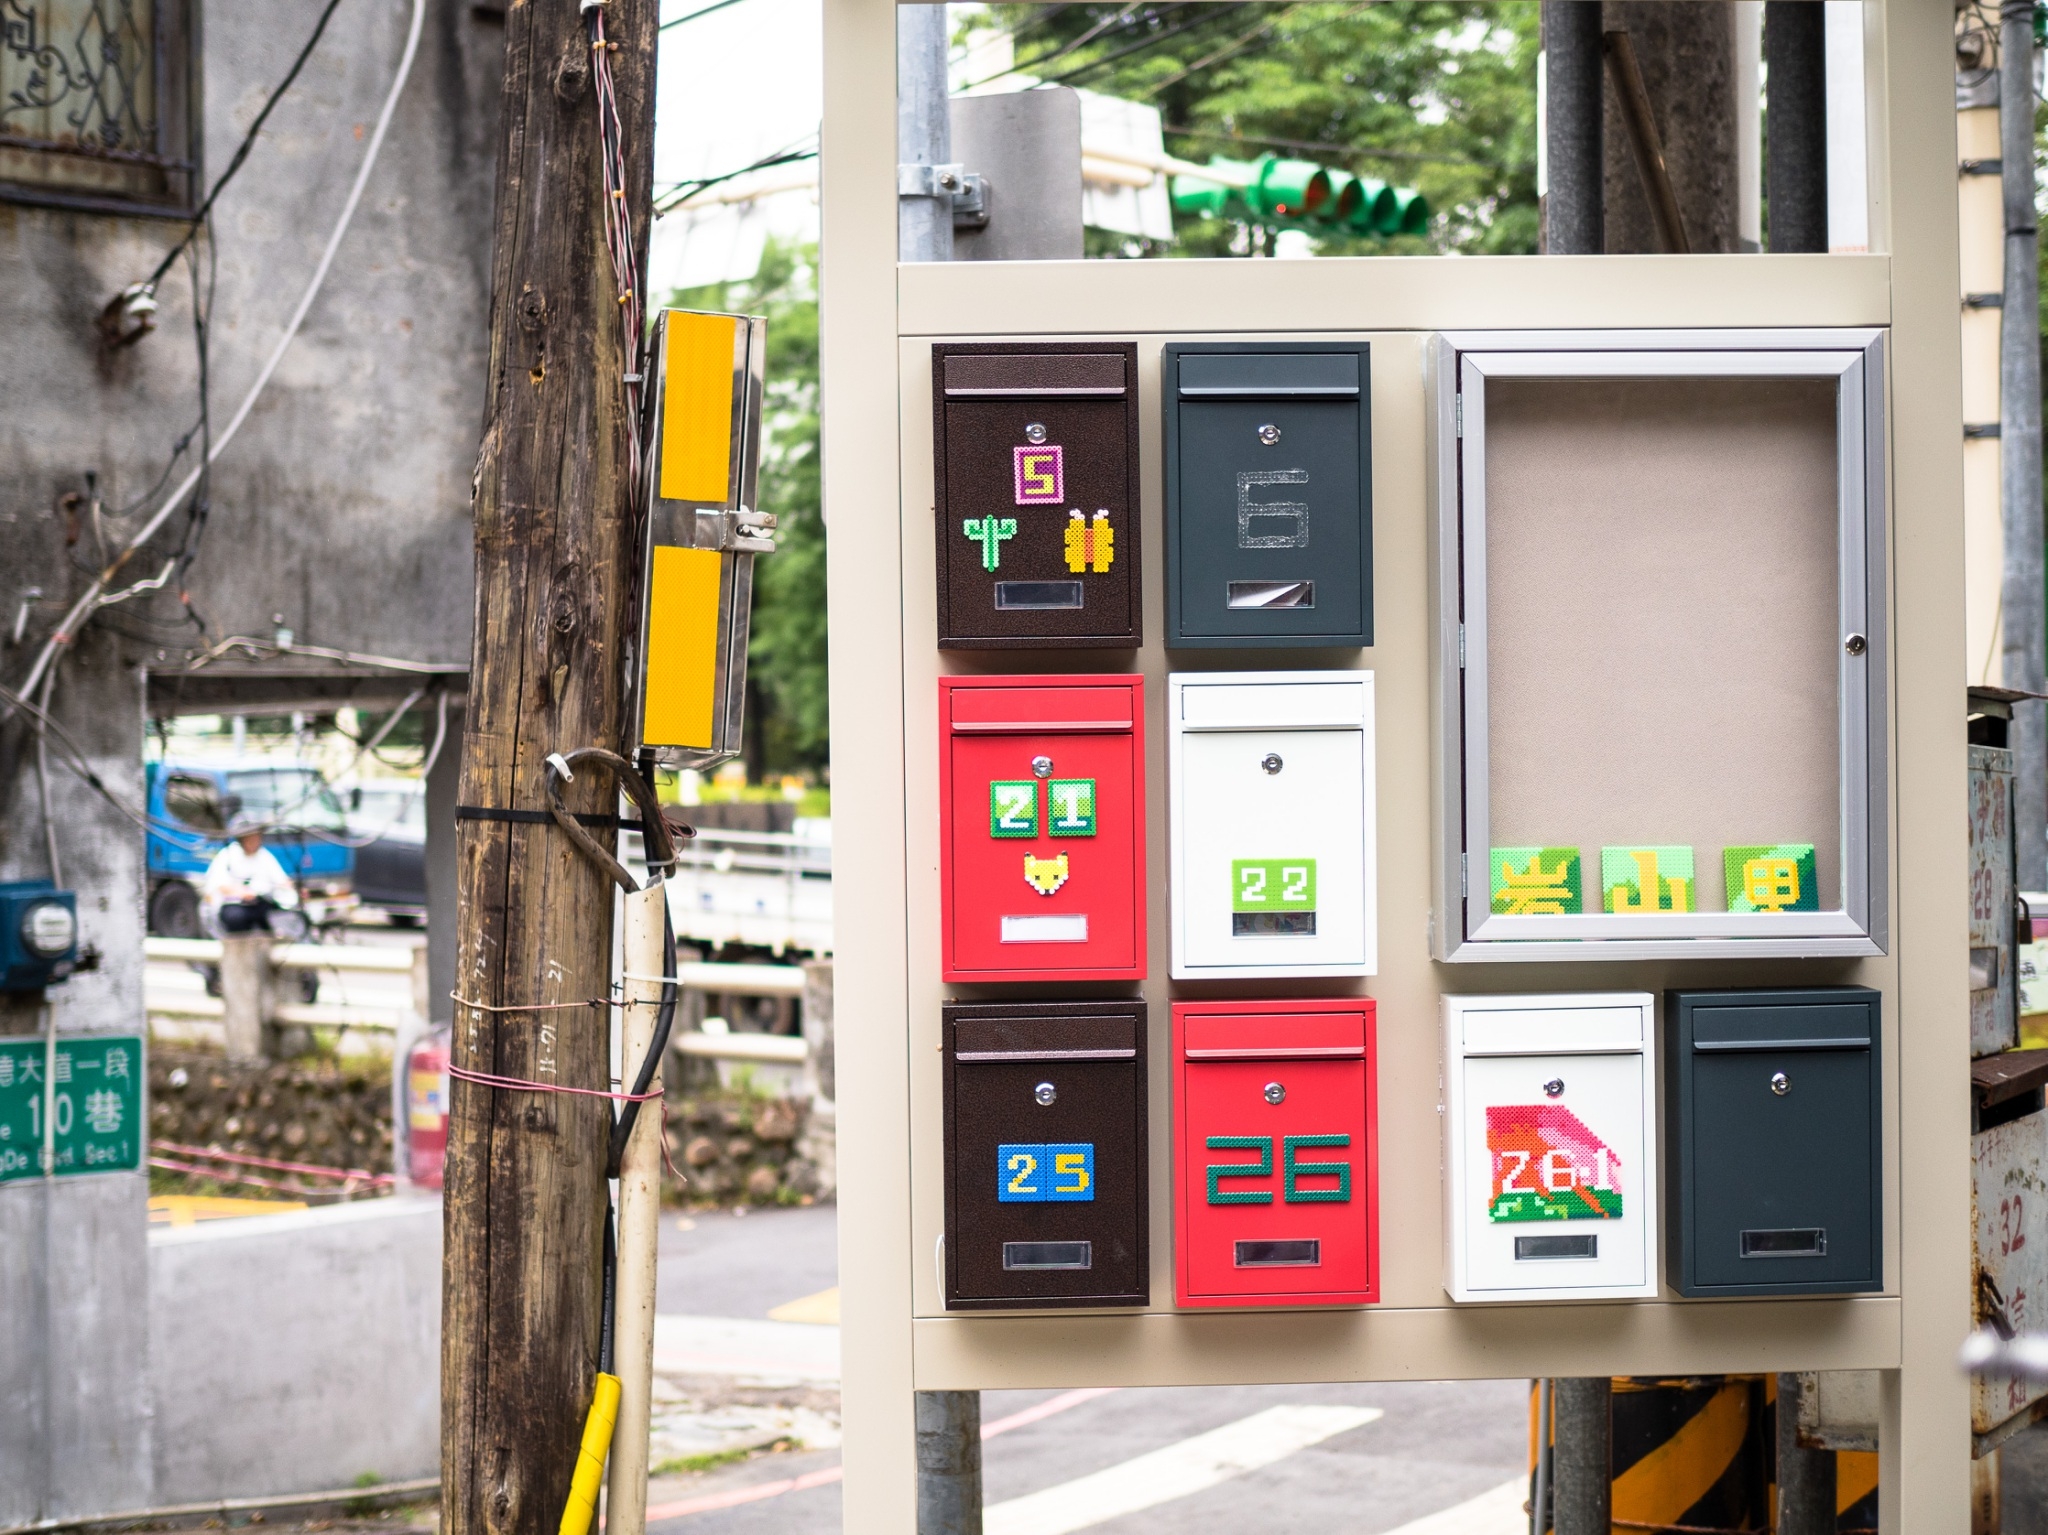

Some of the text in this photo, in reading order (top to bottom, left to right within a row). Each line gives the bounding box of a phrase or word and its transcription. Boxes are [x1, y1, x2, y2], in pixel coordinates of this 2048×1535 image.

[1023, 454, 1054, 494] 5
[1237, 468, 1309, 548] 6
[1000, 787, 1088, 829] 21
[1241, 867, 1307, 901] 22
[1007, 1153, 1090, 1193] 25
[1206, 1134, 1351, 1204] 26
[2001, 1194, 2026, 1257] 32
